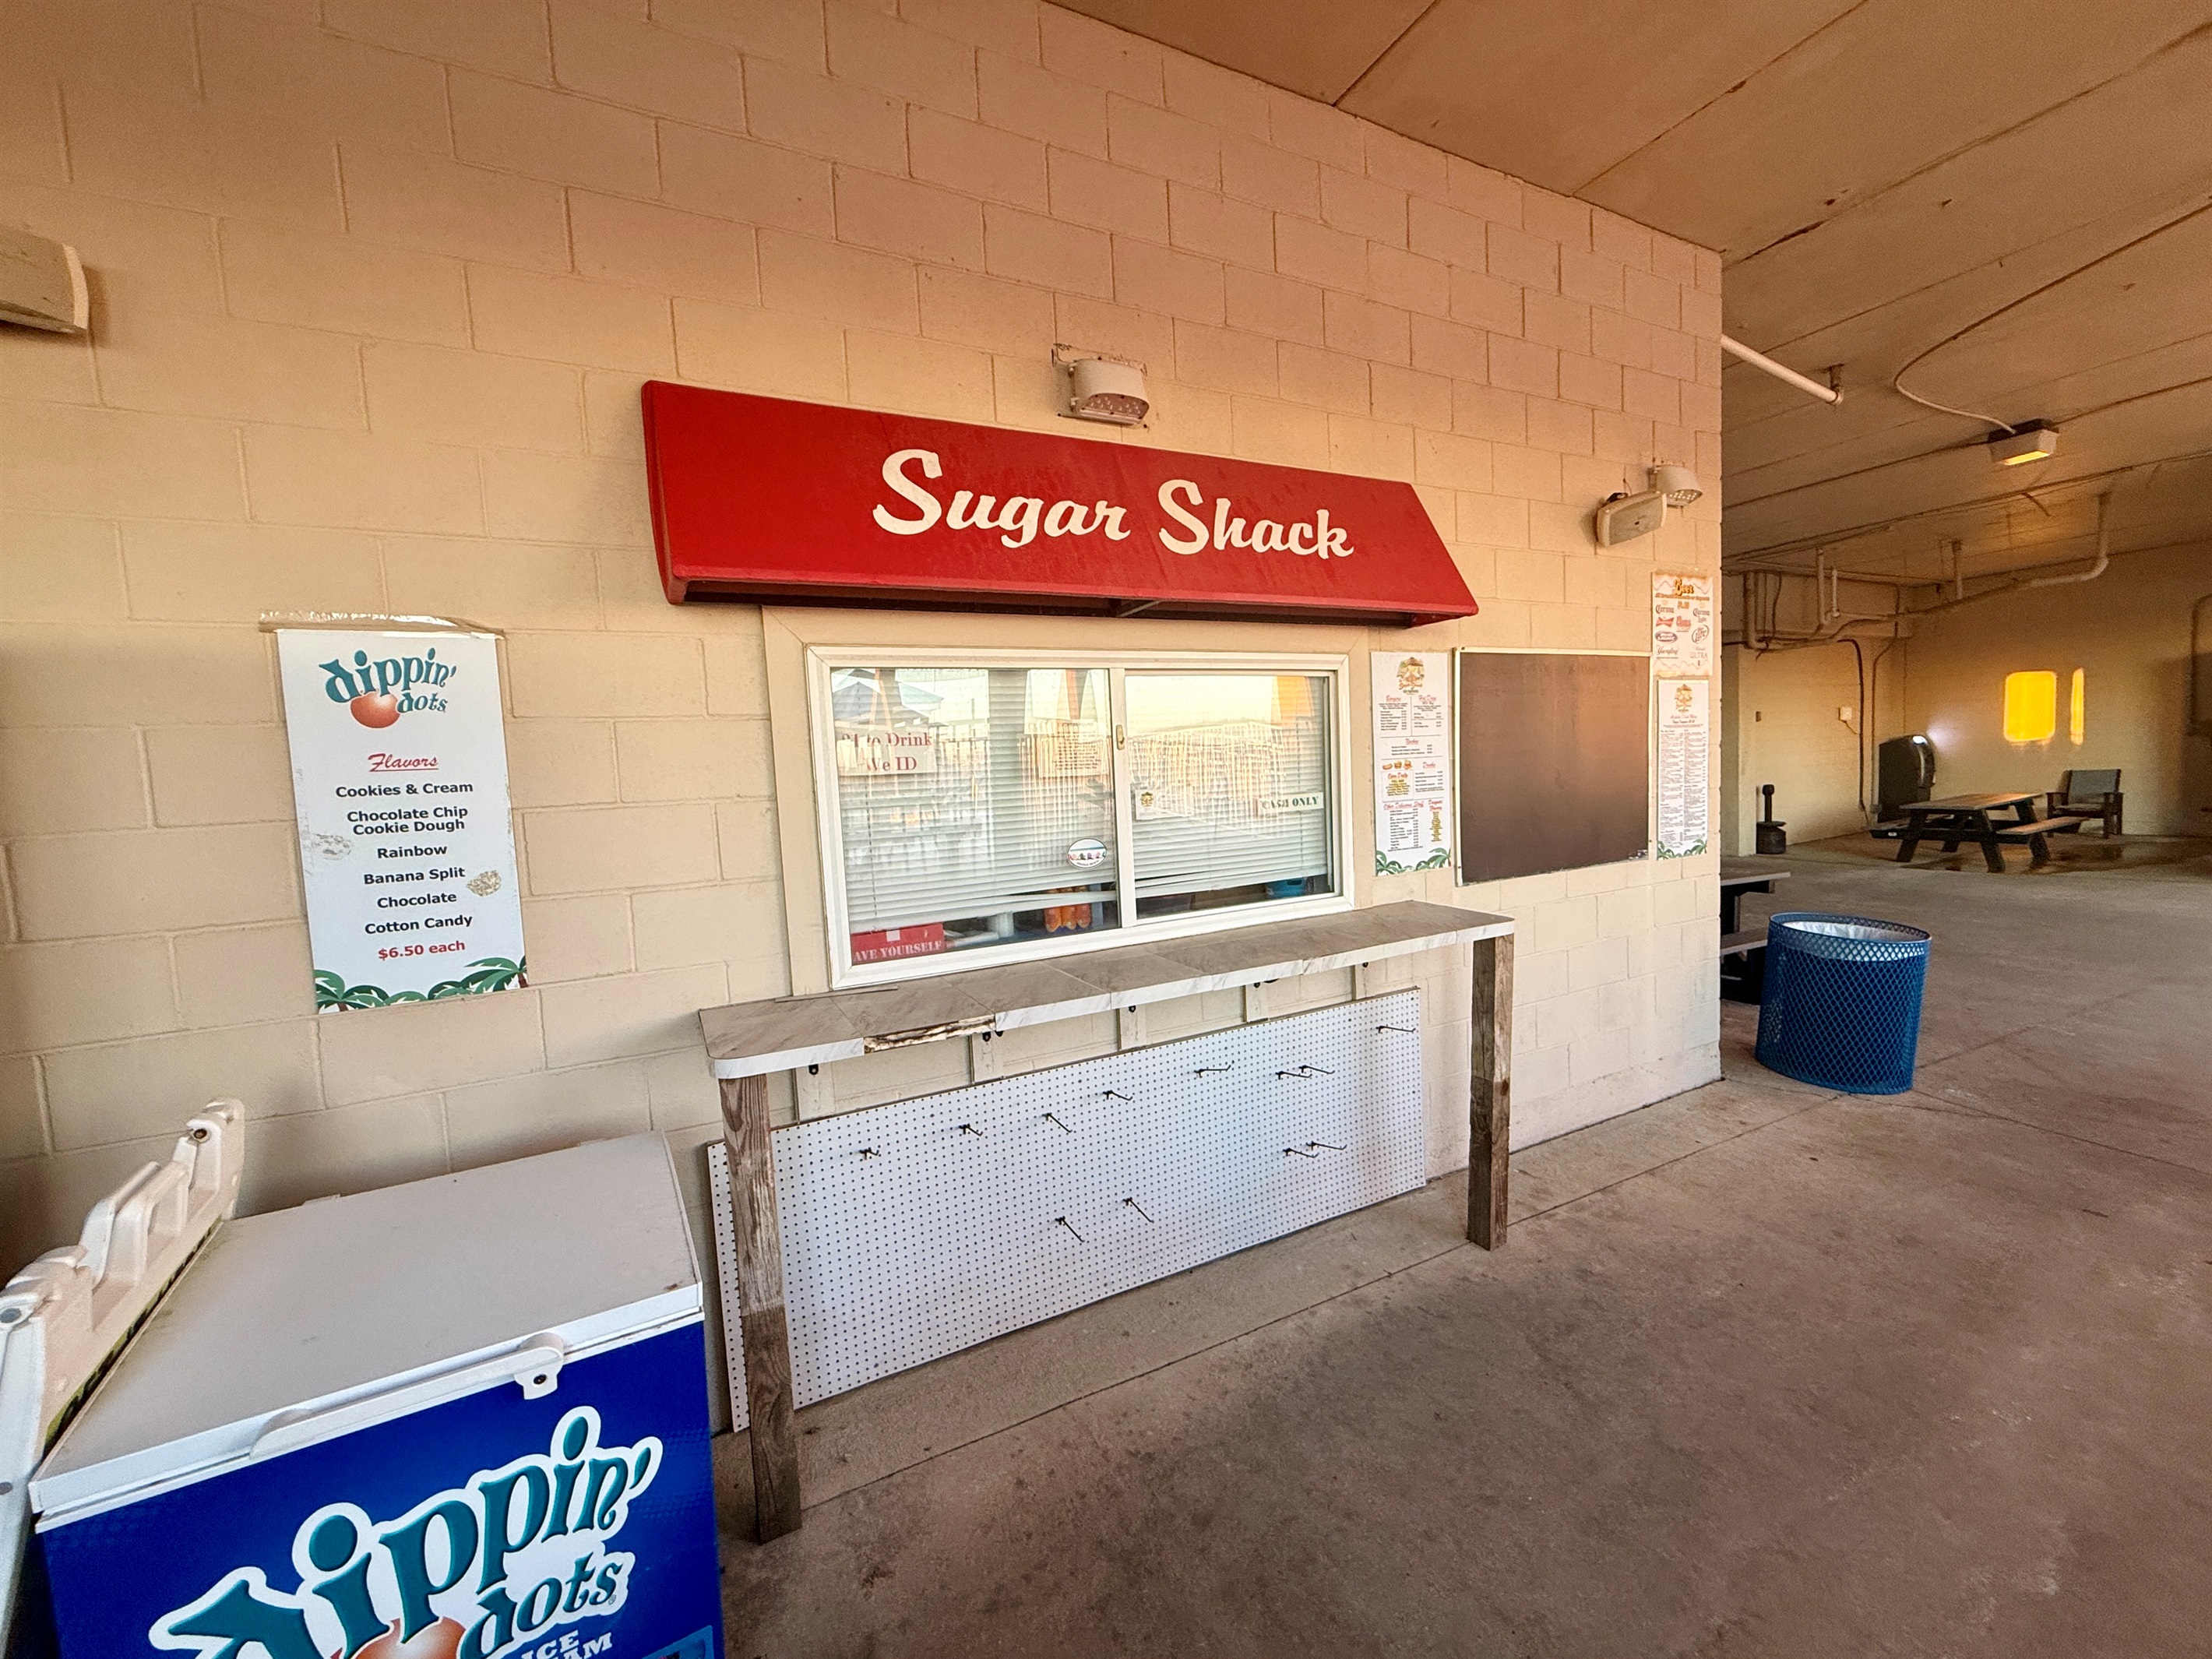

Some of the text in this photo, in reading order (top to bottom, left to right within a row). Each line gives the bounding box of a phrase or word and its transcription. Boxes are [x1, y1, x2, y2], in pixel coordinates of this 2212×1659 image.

[872, 449, 1354, 559] Sugar Shack
[319, 647, 457, 703] dippin'
[396, 692, 449, 713] dots
[885, 732, 932, 747] Drink
[368, 753, 439, 772] Flavors
[895, 756, 918, 771] ID
[336, 783, 474, 798] Cookies & Cream
[1292, 796, 1319, 807] ONLY
[347, 806, 469, 822] Chocolate Chip
[353, 819, 465, 835] Cookie Dough
[377, 845, 448, 858] Rainbow
[364, 867, 466, 885] Banana Split
[377, 893, 457, 908] Chocolate
[365, 914, 473, 934] Cotton Candy
[378, 941, 466, 960] $6.50 each
[854, 940, 942, 962] AVE YOURSELF
[459, 1552, 624, 1659] dots
